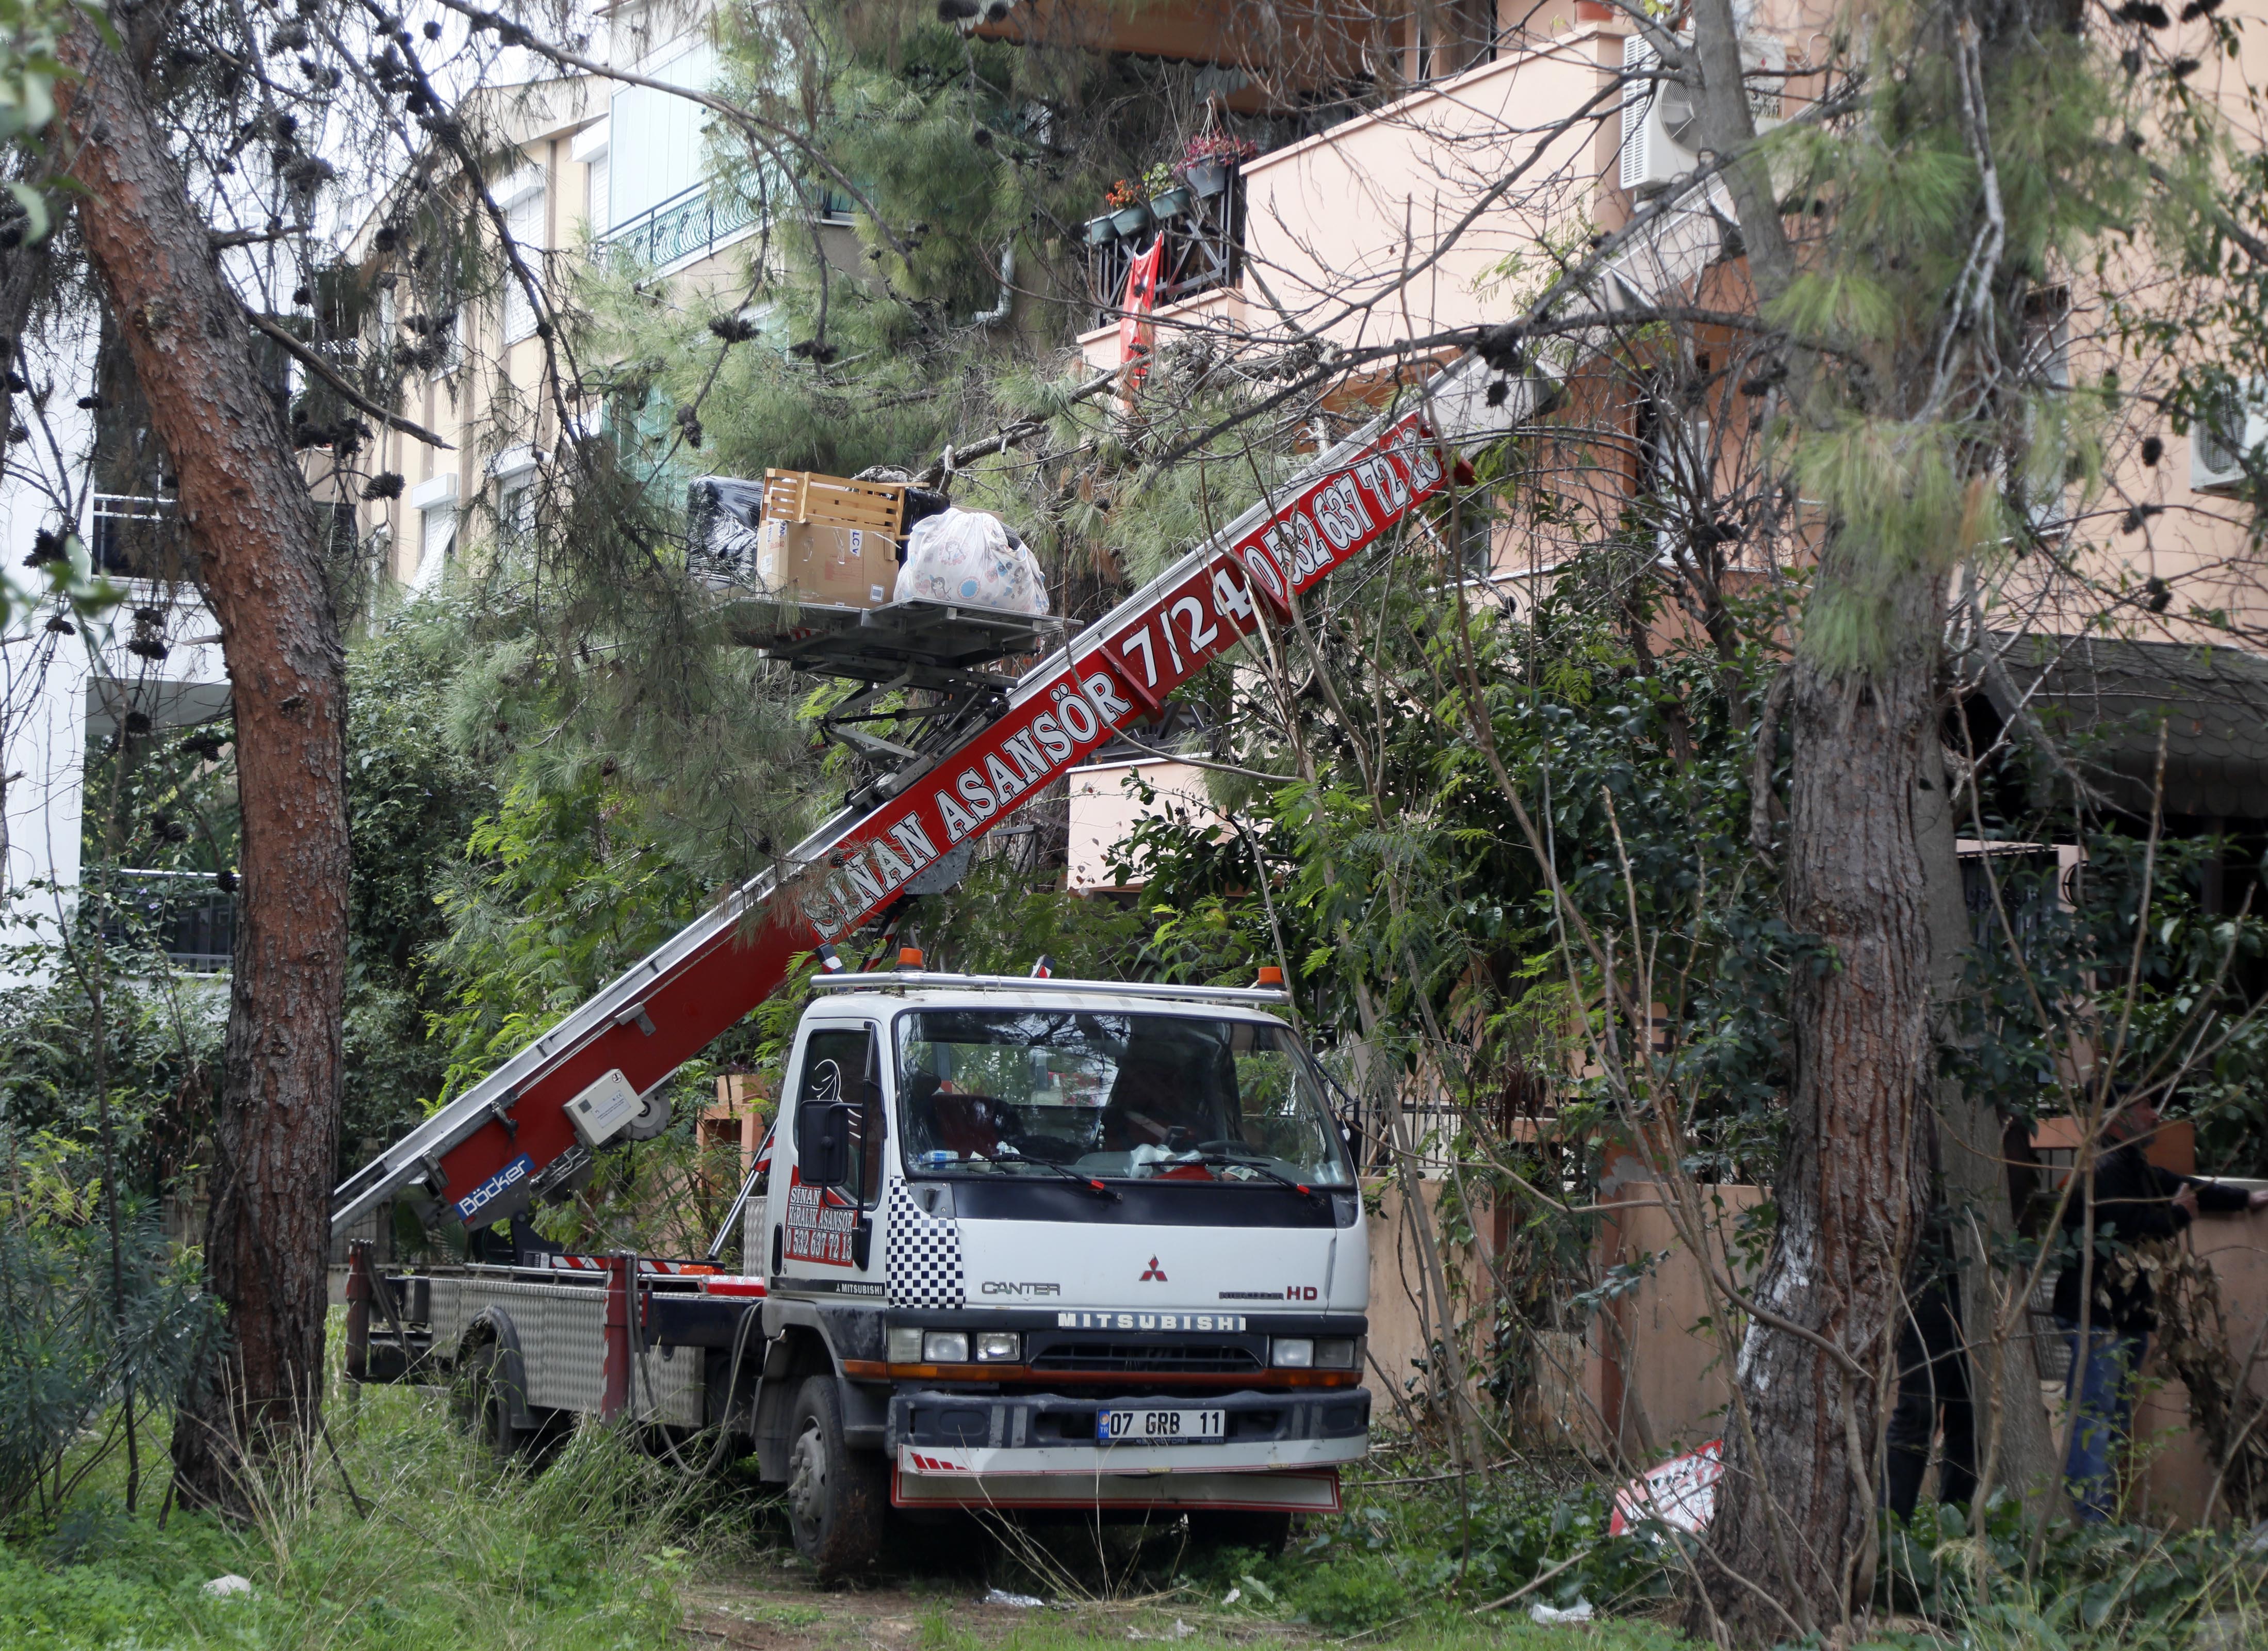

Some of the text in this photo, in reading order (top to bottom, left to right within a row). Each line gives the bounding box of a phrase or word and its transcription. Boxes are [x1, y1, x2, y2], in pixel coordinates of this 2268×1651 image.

[1244, 428, 1441, 598] 0 532 637 72 13
[1122, 566, 1252, 688] 7/24
[935, 672, 1133, 845] ASANSÖR
[459, 1160, 525, 1216] Böcker
[790, 1182, 821, 1207] SİNAN
[785, 1228, 852, 1261] 0 532 637 72 13
[841, 1284, 883, 1294] MITSUBISHI
[981, 1281, 1060, 1296] CANTER
[1286, 1286, 1317, 1300] HD
[1058, 1312, 1246, 1331] MITSUBISHI
[1110, 1412, 1219, 1435] 07 GRB 11
